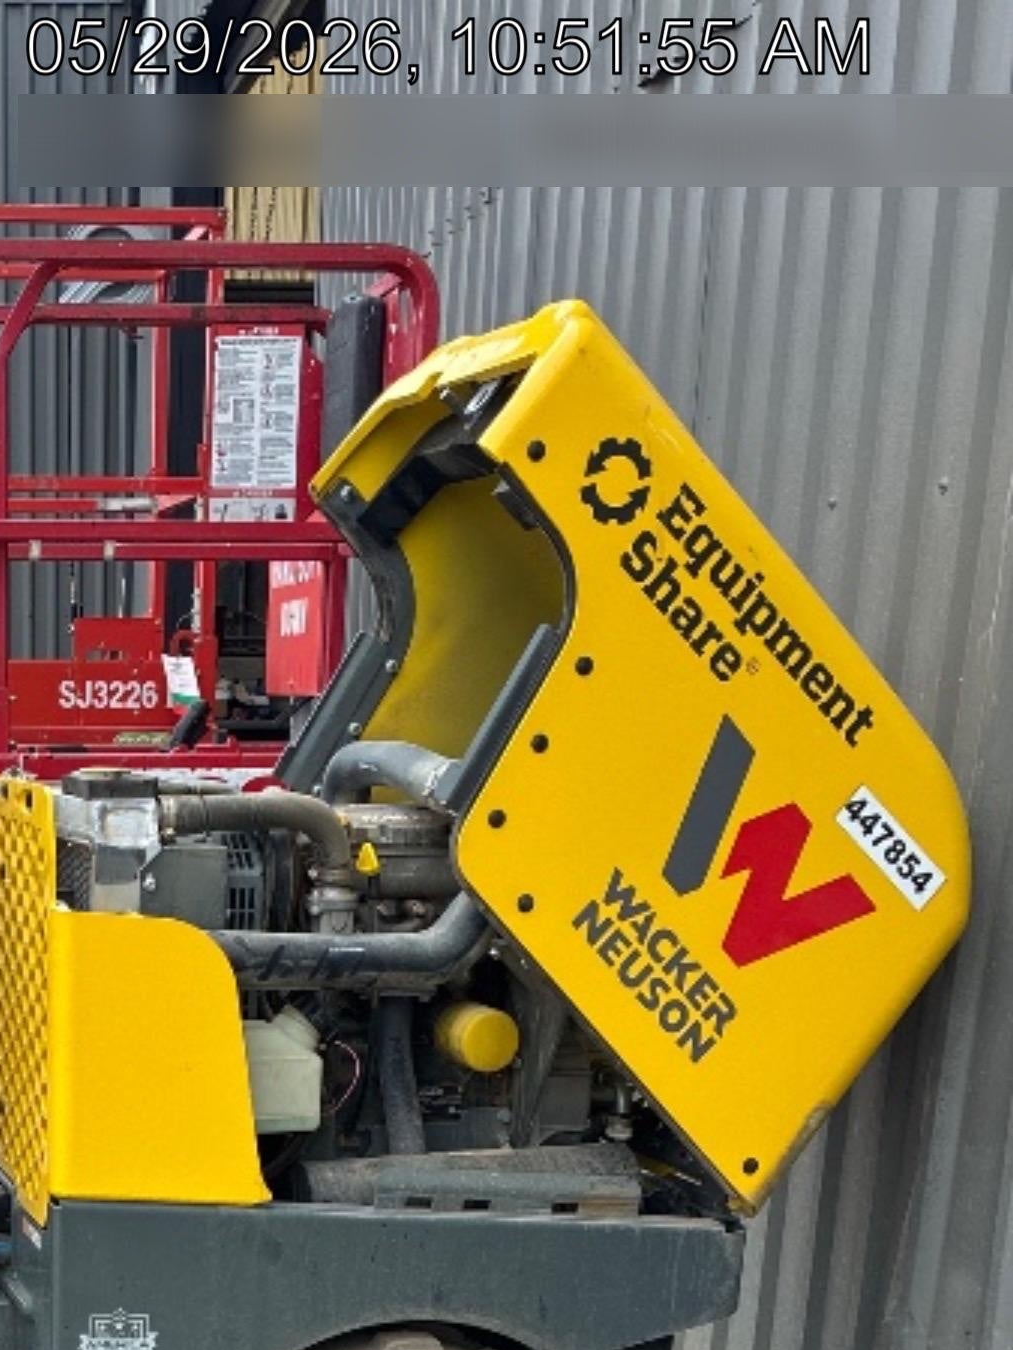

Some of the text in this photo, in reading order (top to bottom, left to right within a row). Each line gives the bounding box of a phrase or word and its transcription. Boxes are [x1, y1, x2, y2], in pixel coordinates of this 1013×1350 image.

[58, 680, 159, 709] SJ3226
[656, 482, 874, 748] Equipment
[845, 797, 934, 895] 447854
[572, 900, 717, 1063] NEUSON
[604, 866, 737, 1038] WACKER
